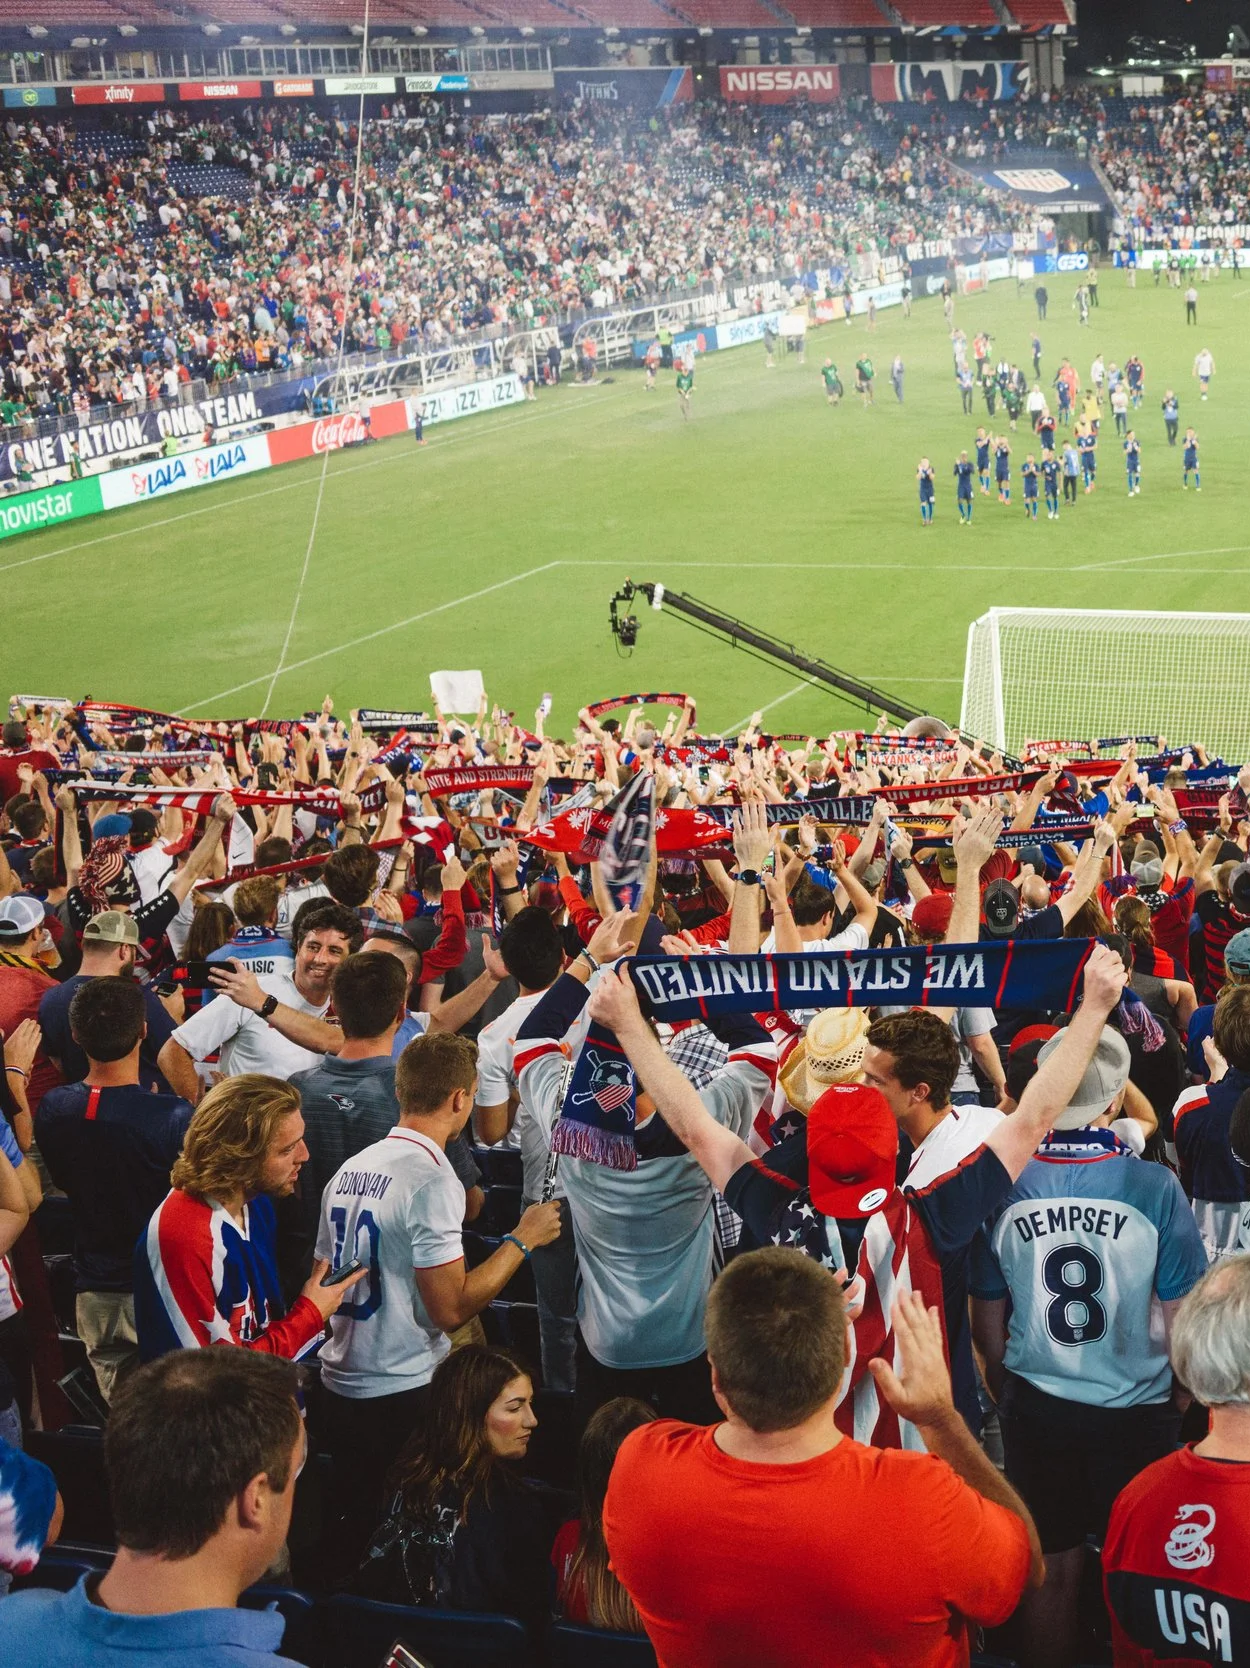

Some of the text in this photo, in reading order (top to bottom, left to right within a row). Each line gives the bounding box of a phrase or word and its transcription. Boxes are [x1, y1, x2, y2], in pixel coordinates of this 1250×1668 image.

[104, 87, 135, 102] xfinity
[203, 84, 239, 96] NISSAN
[576, 80, 618, 100] TITANS
[726, 71, 833, 92] NISSAN
[8, 436, 58, 475] ONE
[60, 416, 149, 465] NATION.
[203, 391, 262, 428] TEAM.
[148, 459, 187, 494] LALA
[209, 445, 246, 478] LALA
[883, 752, 917, 766] YANKS
[428, 767, 534, 790] NITE AND STRENGTHE
[766, 799, 874, 825] NASHVILLE
[246, 960, 275, 975] LISIC
[634, 952, 986, 1005] WE STAND UNITED
[335, 1171, 392, 1201] DONOVAN
[1013, 1205, 1129, 1244] DEMPSEY
[330, 1206, 383, 1321] 10
[1042, 1242, 1107, 1348] 8
[1154, 1588, 1233, 1663] USA
